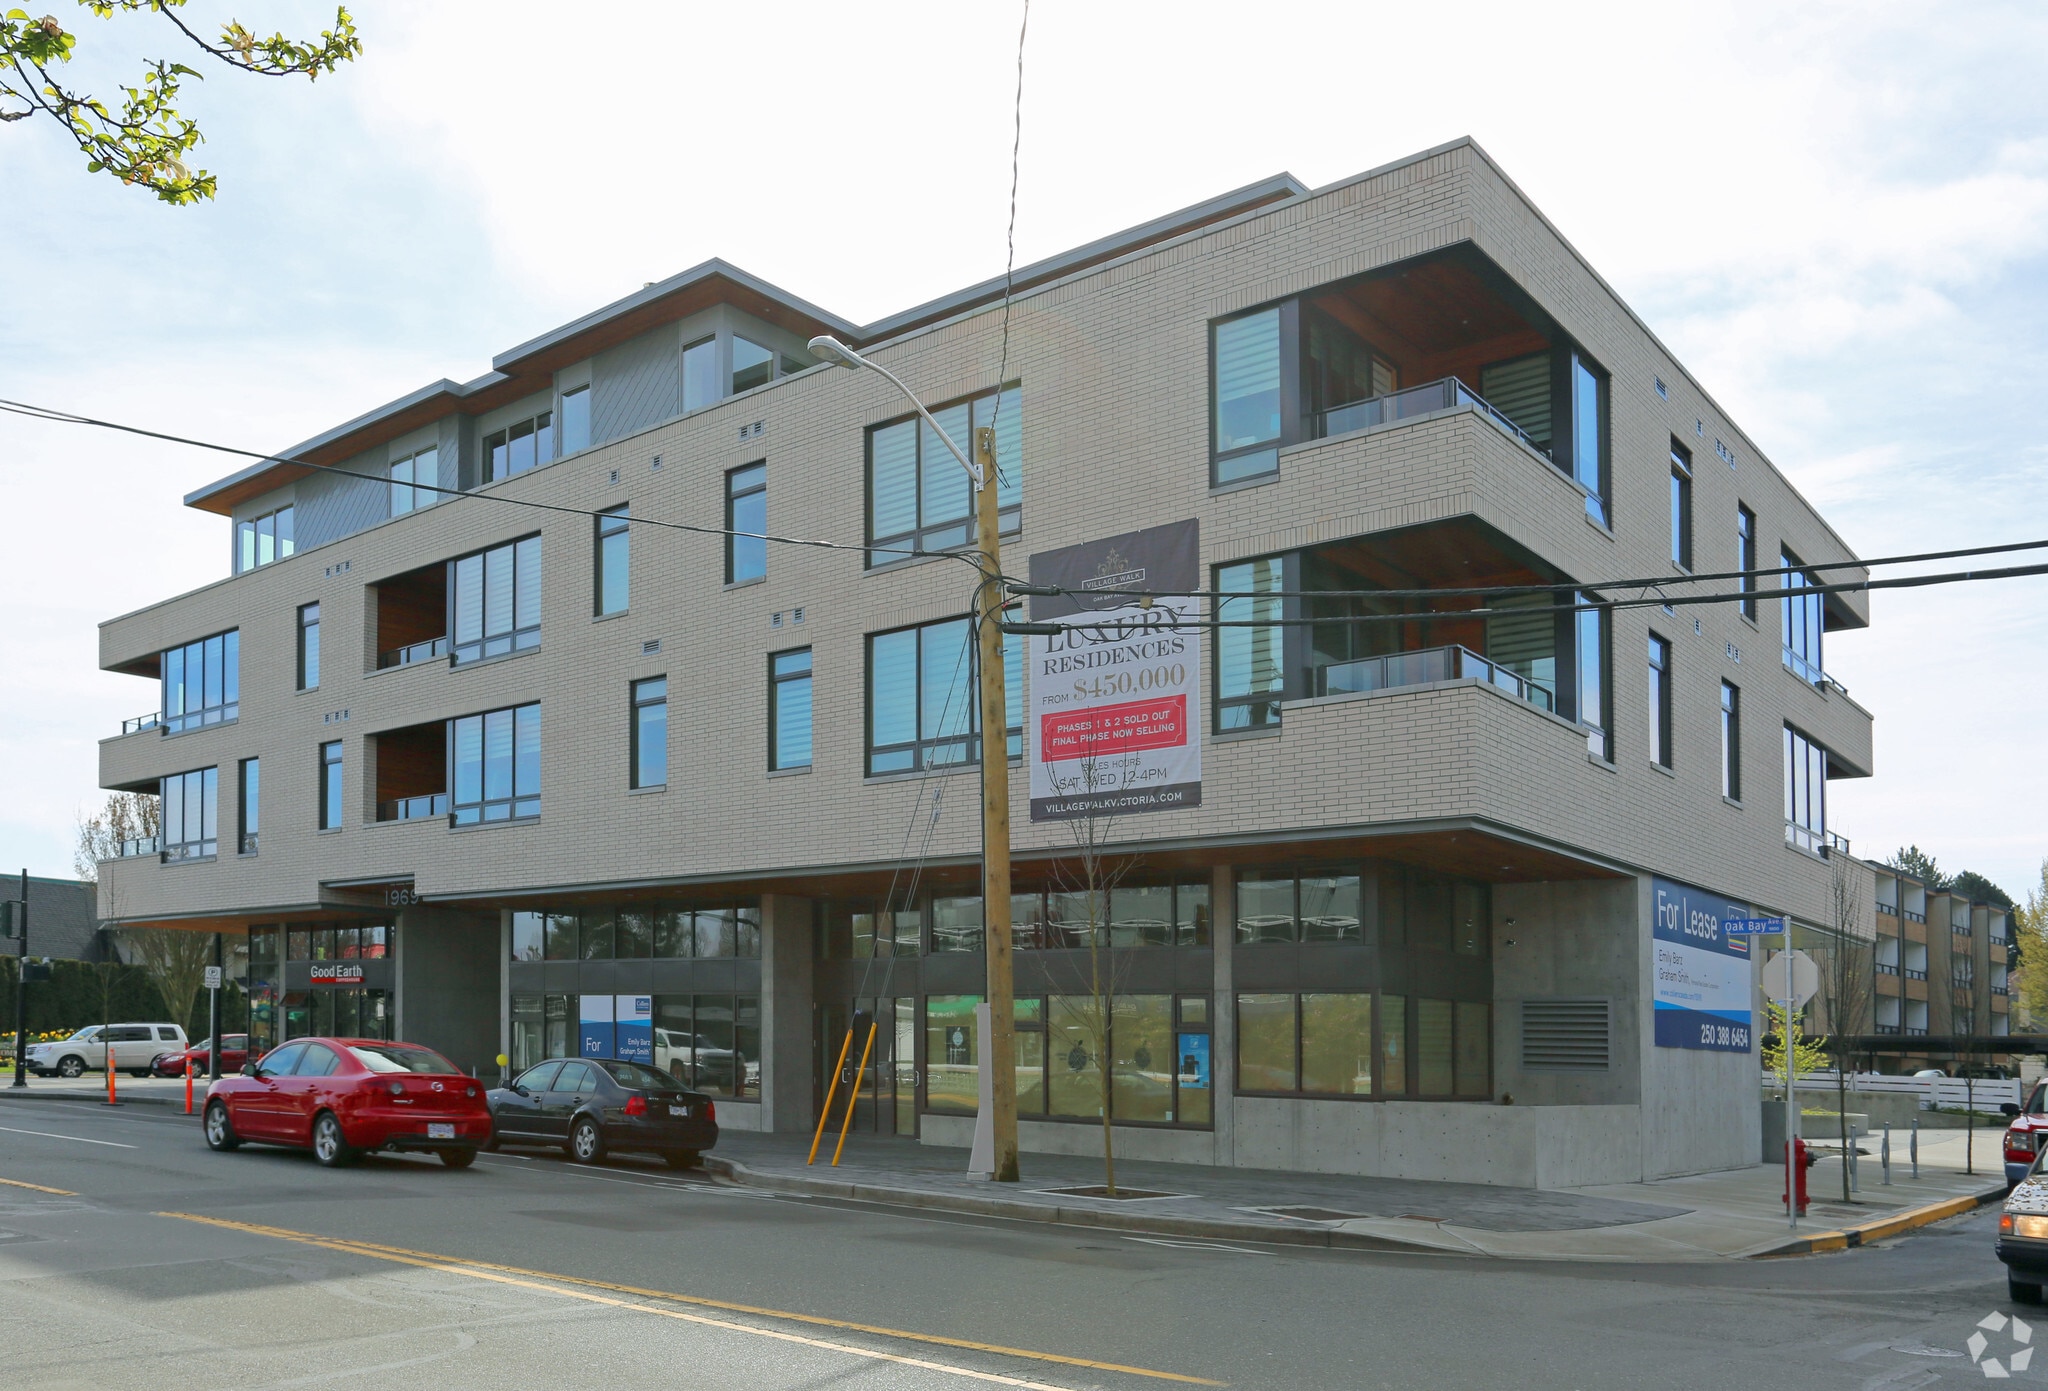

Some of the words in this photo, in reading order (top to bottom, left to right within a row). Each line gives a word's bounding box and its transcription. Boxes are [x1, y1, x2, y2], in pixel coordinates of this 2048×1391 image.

[1086, 577, 1117, 589] VILLAGE
[1120, 572, 1141, 582] WALK
[1045, 606, 1187, 654] LUXURY
[1043, 637, 1185, 676] RESIDENCES
[1042, 693, 1069, 706] FROM
[1073, 663, 1185, 701] $450,000
[1057, 721, 1092, 734] PHASES
[1096, 719, 1100, 729] 1
[1104, 718, 1111, 727] &
[1114, 717, 1120, 726] 2
[1124, 713, 1149, 725] SOLD
[1151, 710, 1170, 721] OUT
[1053, 736, 1077, 746] FINAL
[1080, 731, 1109, 743] PHASE
[1113, 728, 1133, 739] NOW
[1136, 722, 1175, 736] SELLING
[1112, 757, 1141, 768] HOURS
[1123, 767, 1167, 783] 12-4PM
[1046, 792, 1182, 813] VILLAGEWALKVCTORIA.COM
[385, 889, 419, 905] 1969
[1658, 889, 1679, 931] For
[1683, 896, 1718, 941] Lease
[1724, 921, 1744, 932] Oak
[1748, 921, 1767, 933] Bay
[1659, 949, 1672, 966] Emily
[1673, 951, 1683, 966] Barz
[310, 965, 335, 978] Good
[336, 964, 363, 977] Earth
[627, 1037, 640, 1047] Emily
[640, 1038, 651, 1046] Barz
[1701, 1023, 1716, 1045] 250
[1717, 1025, 1730, 1046] 388
[1731, 1027, 1748, 1048] 6454
[586, 1037, 601, 1052] For
[620, 1047, 636, 1055] Graham
